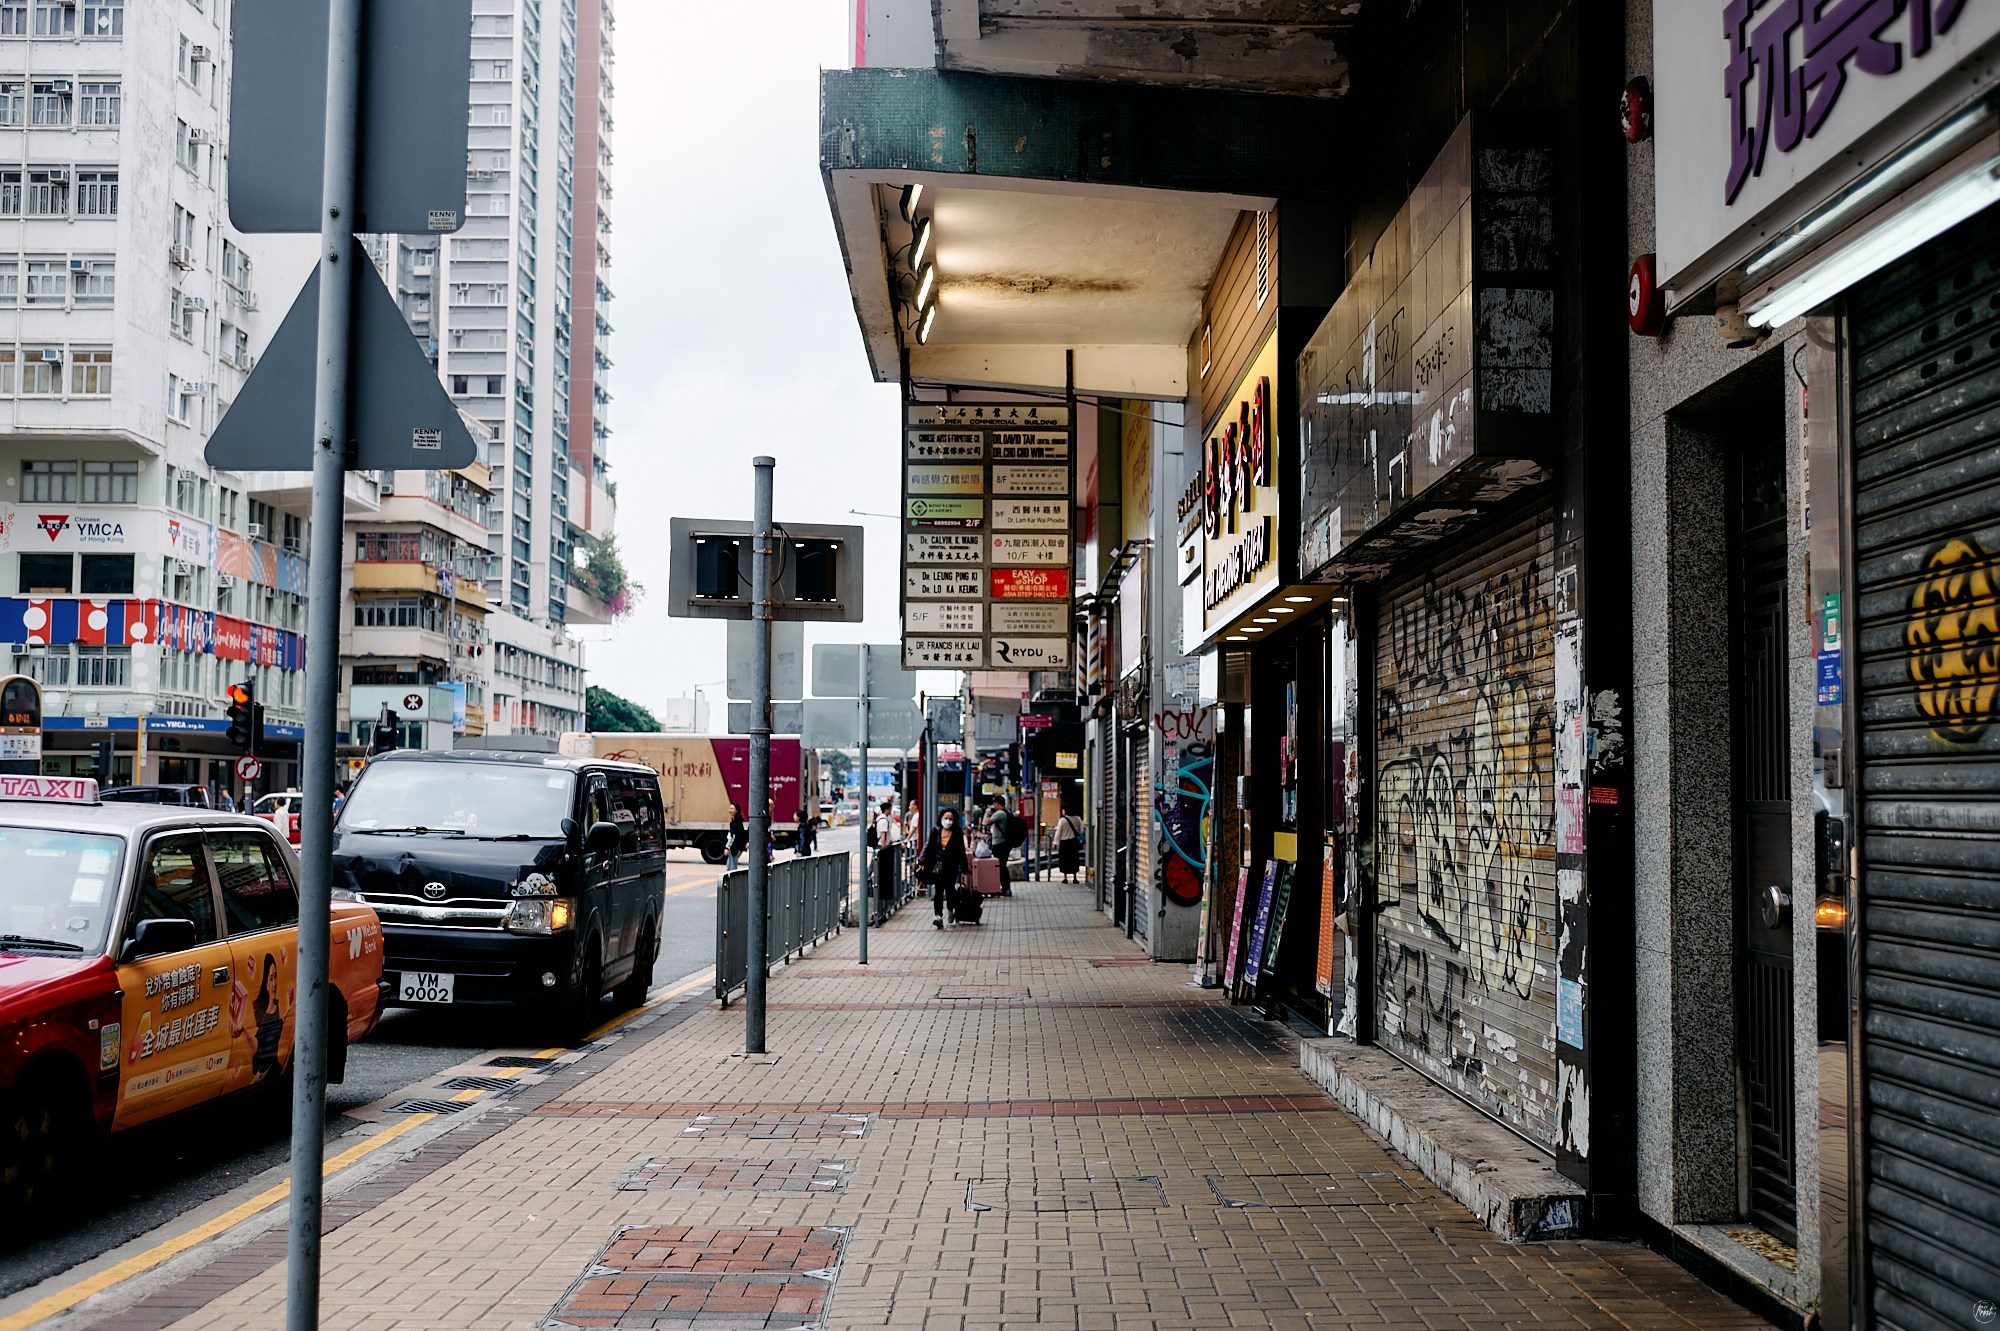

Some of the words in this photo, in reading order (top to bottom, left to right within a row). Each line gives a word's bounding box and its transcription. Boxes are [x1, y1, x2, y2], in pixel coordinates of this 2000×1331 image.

[1003, 434, 1021, 445] DAVID
[1022, 434, 1035, 445] TAN
[965, 519, 980, 527] 2/F
[77, 523, 124, 536] YMCA
[931, 536, 952, 544] CALVIN
[962, 536, 978, 545] WANG
[1007, 552, 1028, 560] 10/F
[933, 571, 953, 581] LEUNG
[955, 571, 969, 581] PING
[971, 572, 978, 580] KI
[1012, 570, 1035, 578] EASY
[1022, 576, 1048, 585] SHOP
[933, 585, 941, 593] LO
[946, 585, 954, 593] KA
[959, 585, 978, 593] KEUNG
[912, 612, 928, 621] 5/F
[927, 641, 952, 650] FRANCIS
[967, 642, 980, 650] LAU
[1012, 648, 1044, 657] RYDU
[151, 720, 204, 730] www.YMCA.org.hk
[1, 777, 85, 799] TAXI
[361, 921, 378, 937] WeLab
[364, 939, 378, 954] Bank
[417, 973, 439, 988] VM
[404, 986, 449, 1002] 9002
